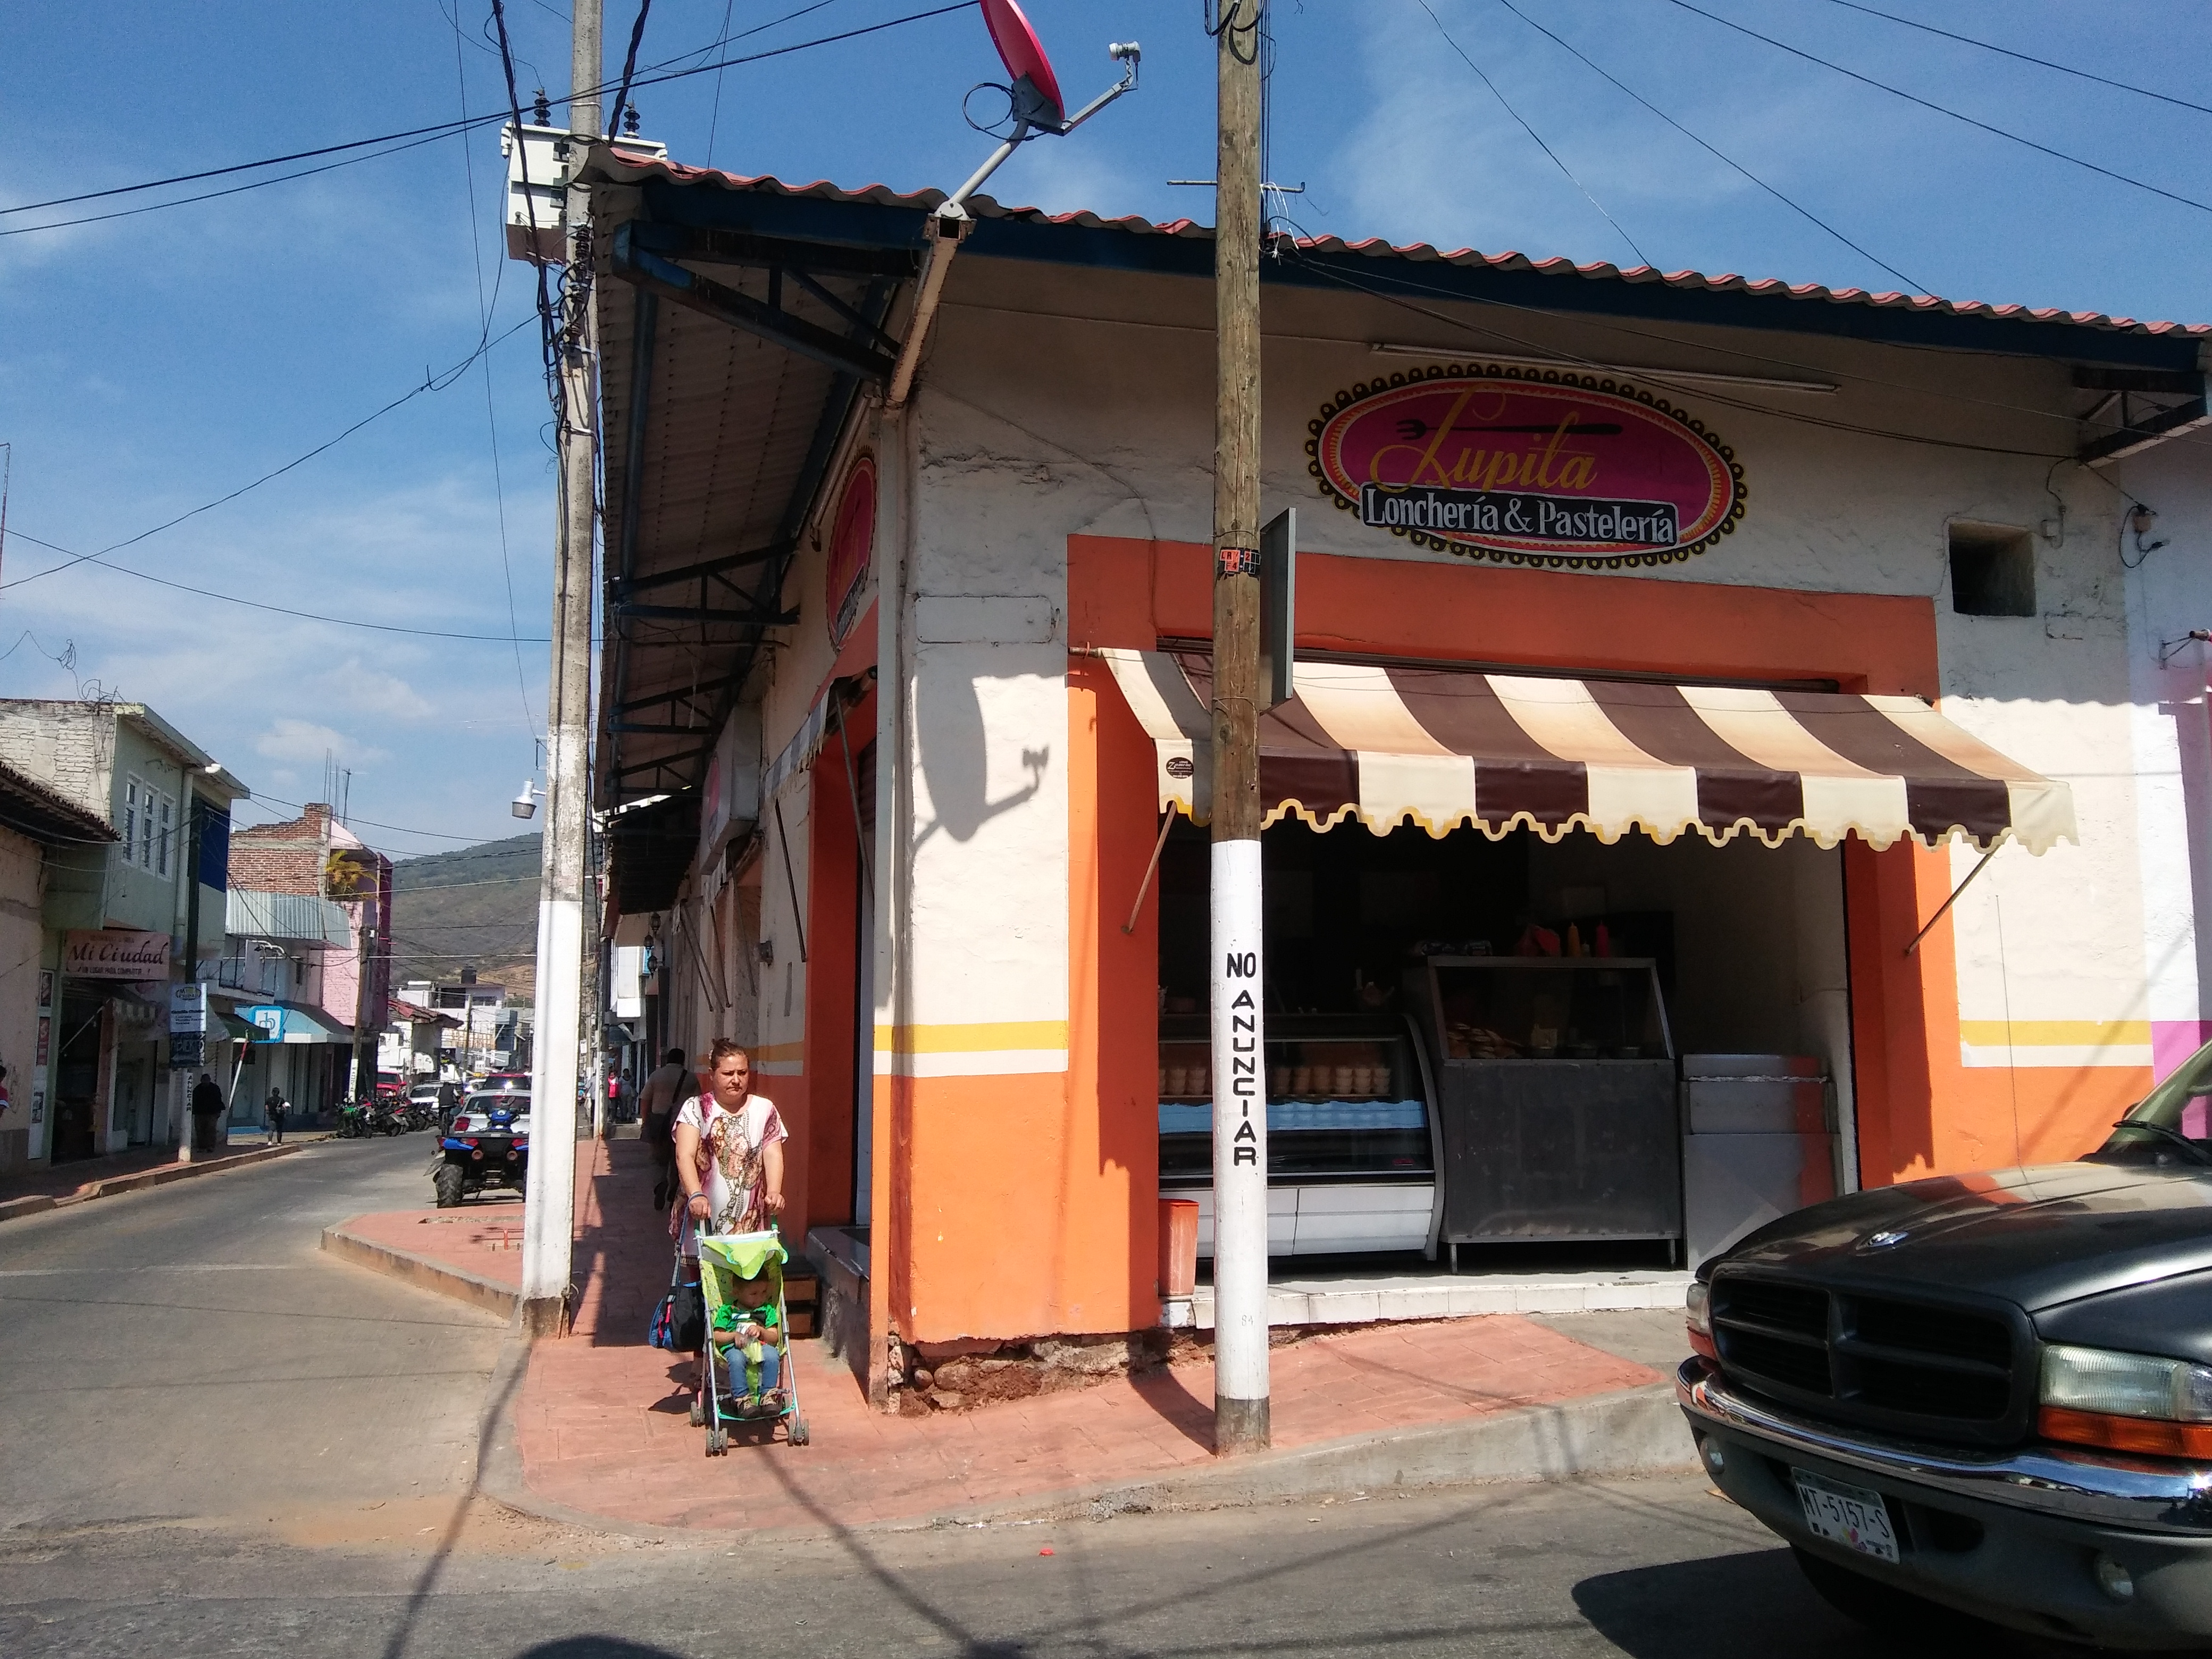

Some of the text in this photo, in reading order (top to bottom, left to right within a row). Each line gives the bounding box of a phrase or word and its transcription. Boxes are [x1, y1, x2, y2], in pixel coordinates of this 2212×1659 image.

[1370, 382, 1599, 492] Lupita
[1366, 488, 1674, 544] Lonchería & Pastelería
[99, 940, 168, 965] Ciudad
[1226, 952, 1256, 978] NO
[1231, 990, 1257, 1166] ANUNCIAR
